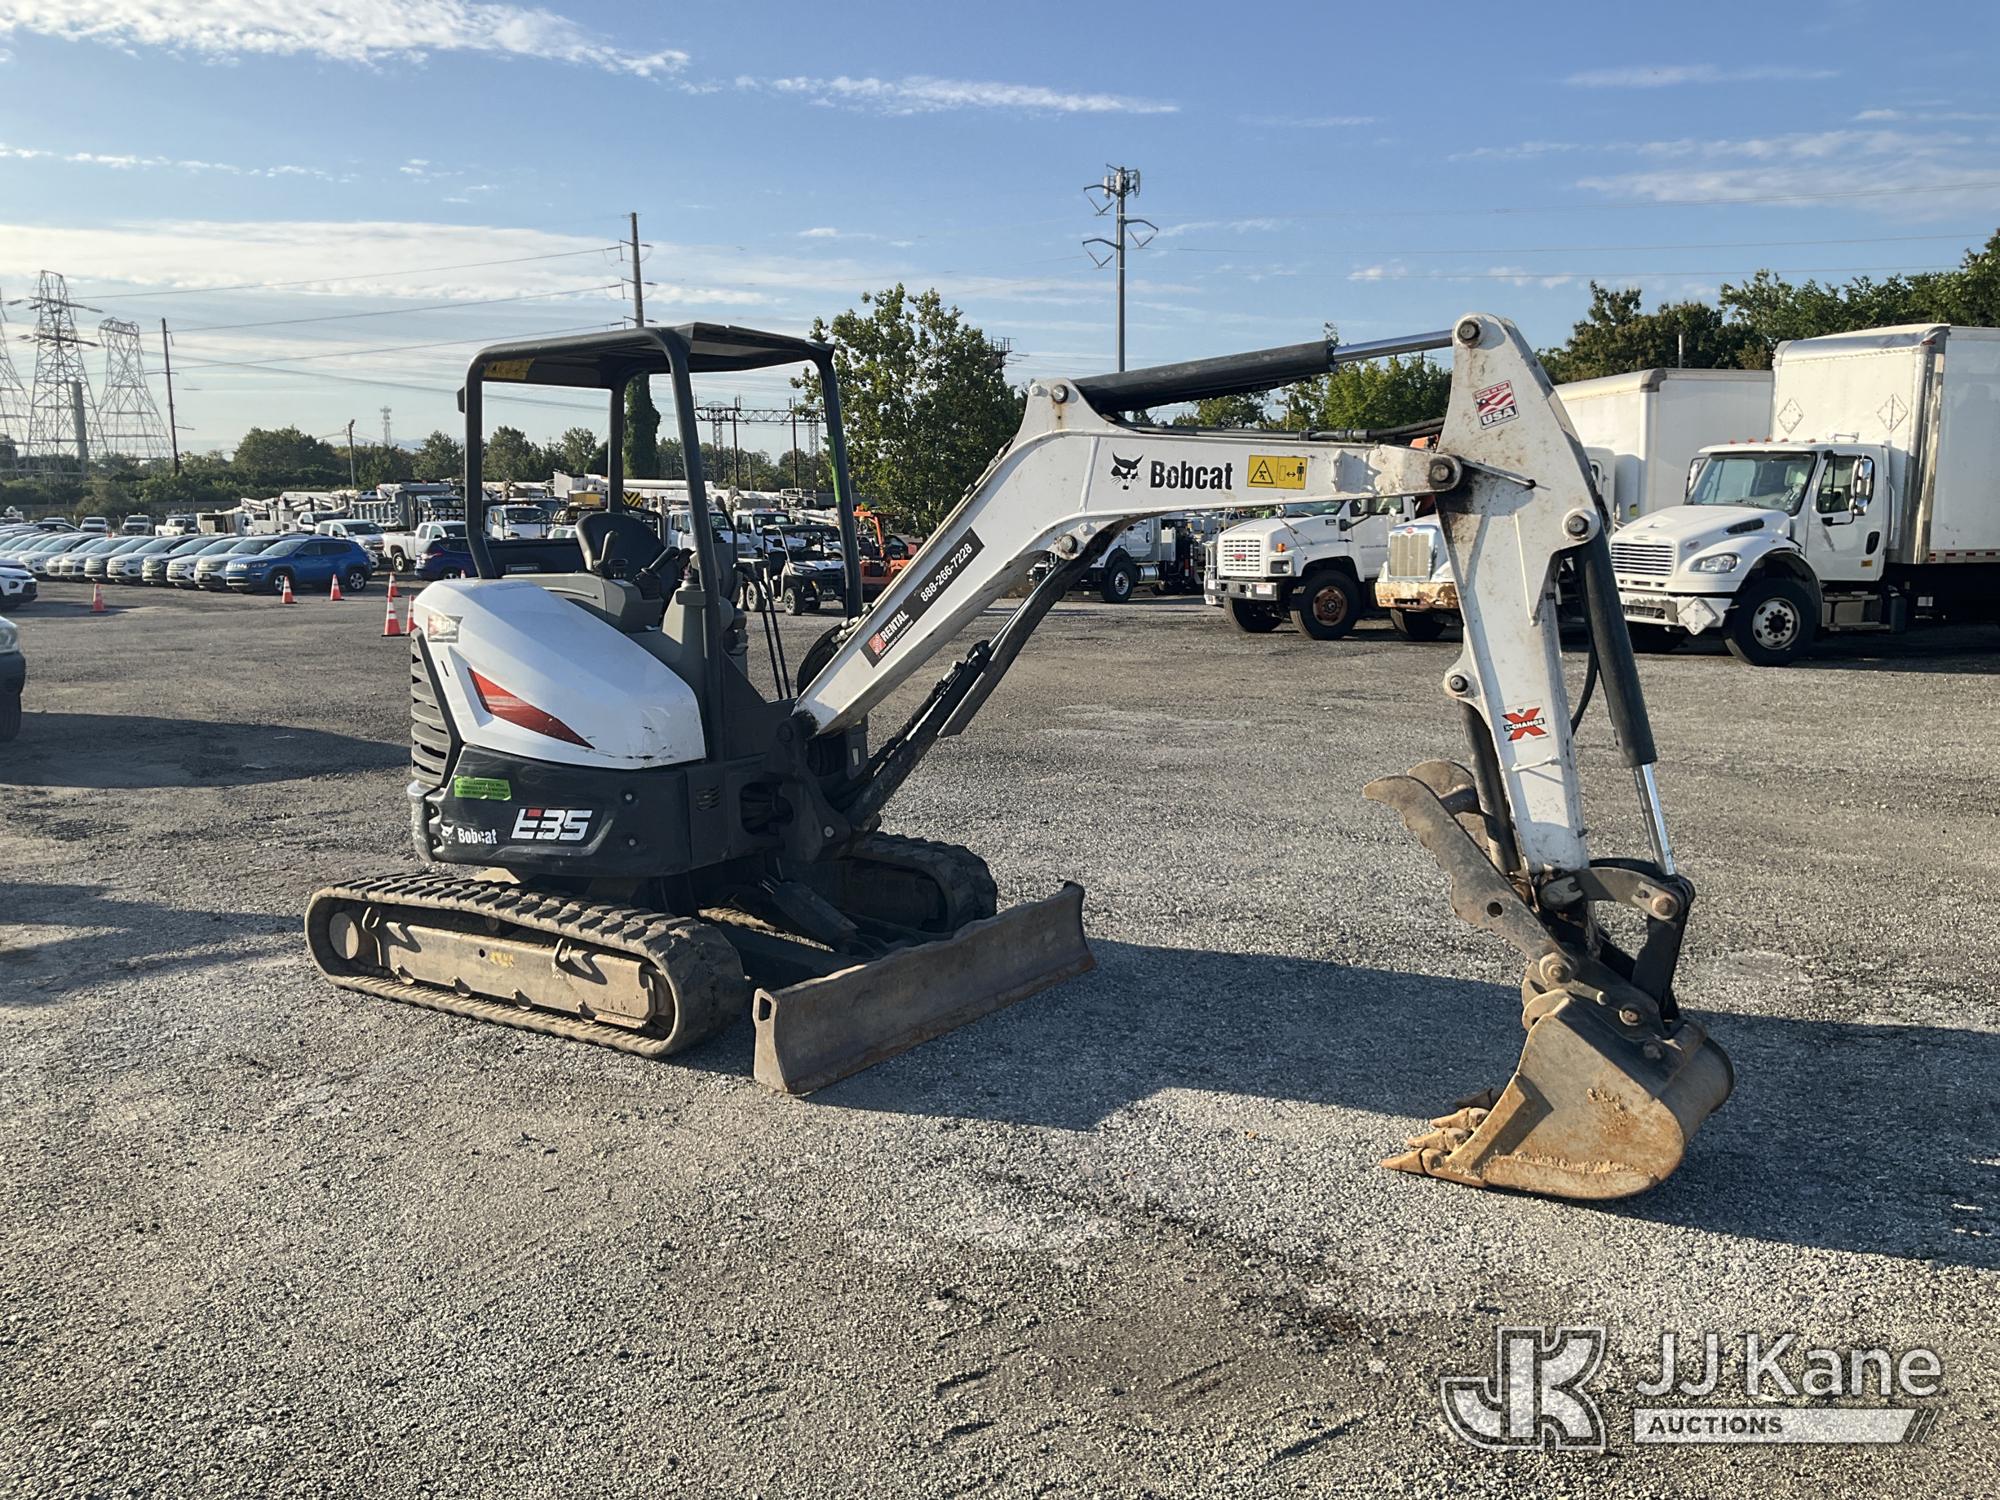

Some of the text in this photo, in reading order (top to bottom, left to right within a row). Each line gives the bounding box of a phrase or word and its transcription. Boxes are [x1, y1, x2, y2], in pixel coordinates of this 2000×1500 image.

[1482, 407, 1514, 424] USA
[1150, 460, 1233, 490] Bobcat
[920, 542, 973, 602] 888-266-7228
[879, 610, 910, 643] RENTAL
[457, 827, 498, 844] Bobcat
[511, 808, 593, 841] E35
